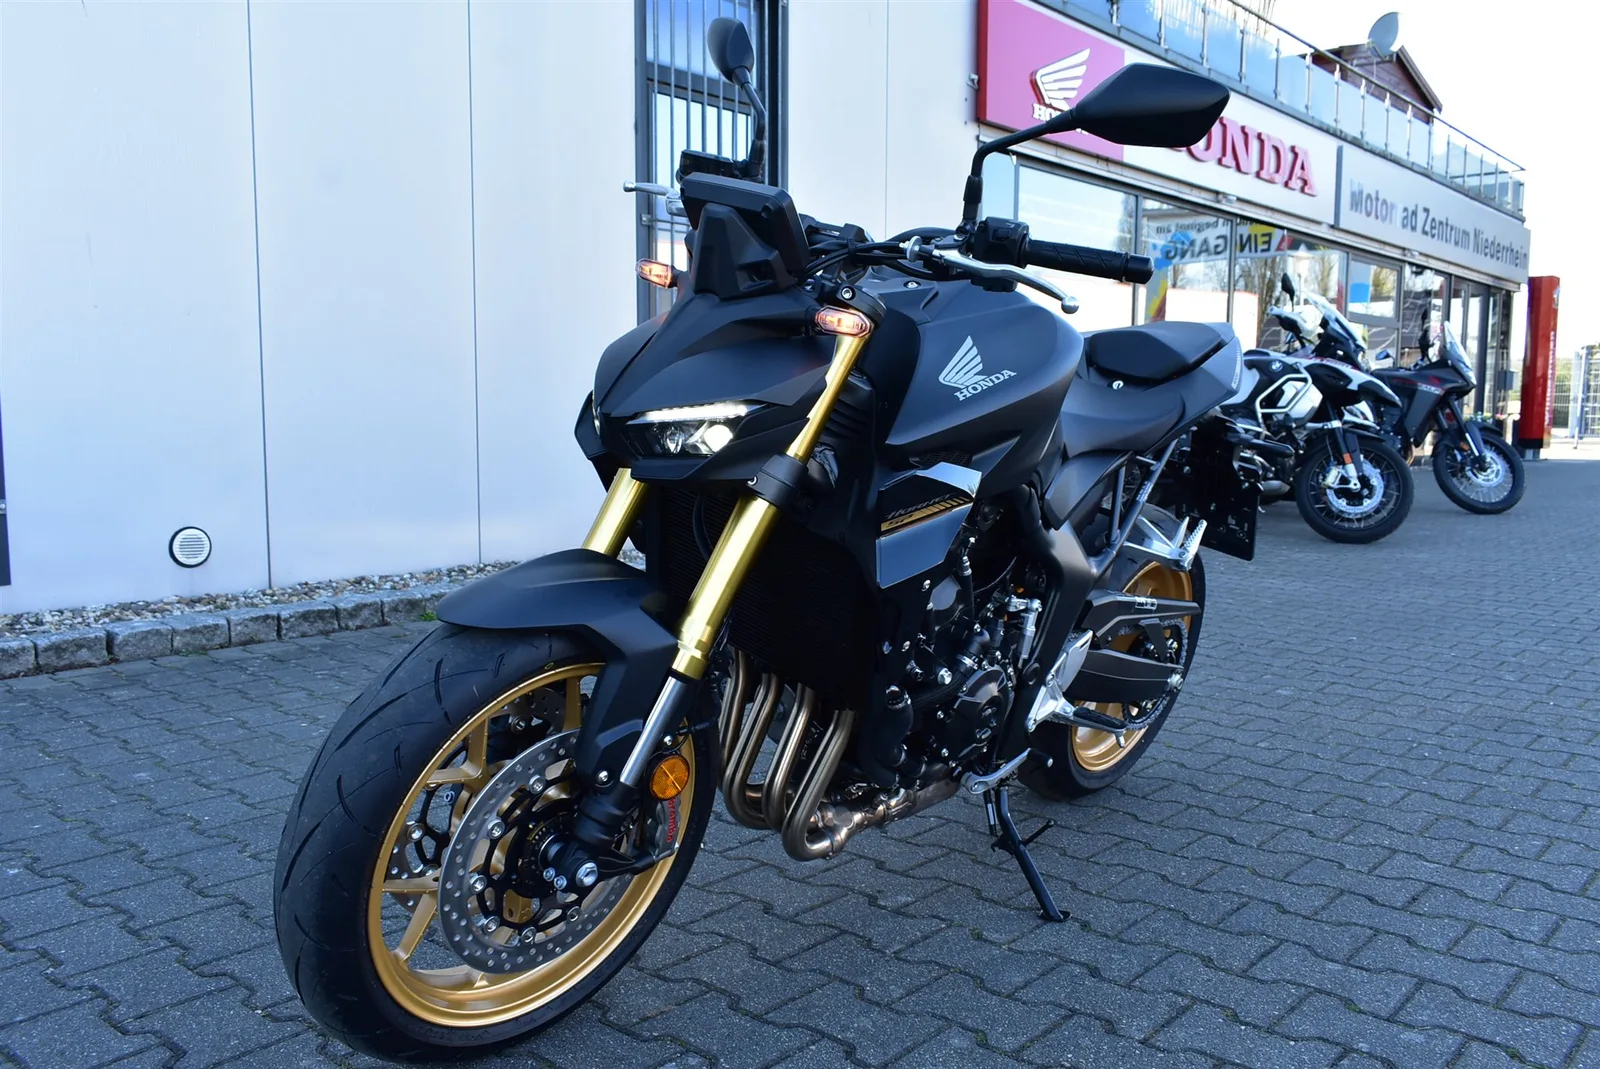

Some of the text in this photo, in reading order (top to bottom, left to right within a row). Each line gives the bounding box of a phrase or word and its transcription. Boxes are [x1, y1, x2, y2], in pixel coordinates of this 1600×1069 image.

[1421, 207, 1470, 249] Zentrum
[1472, 227, 1527, 270] Niederrhein
[954, 369, 1017, 401] HONDA
